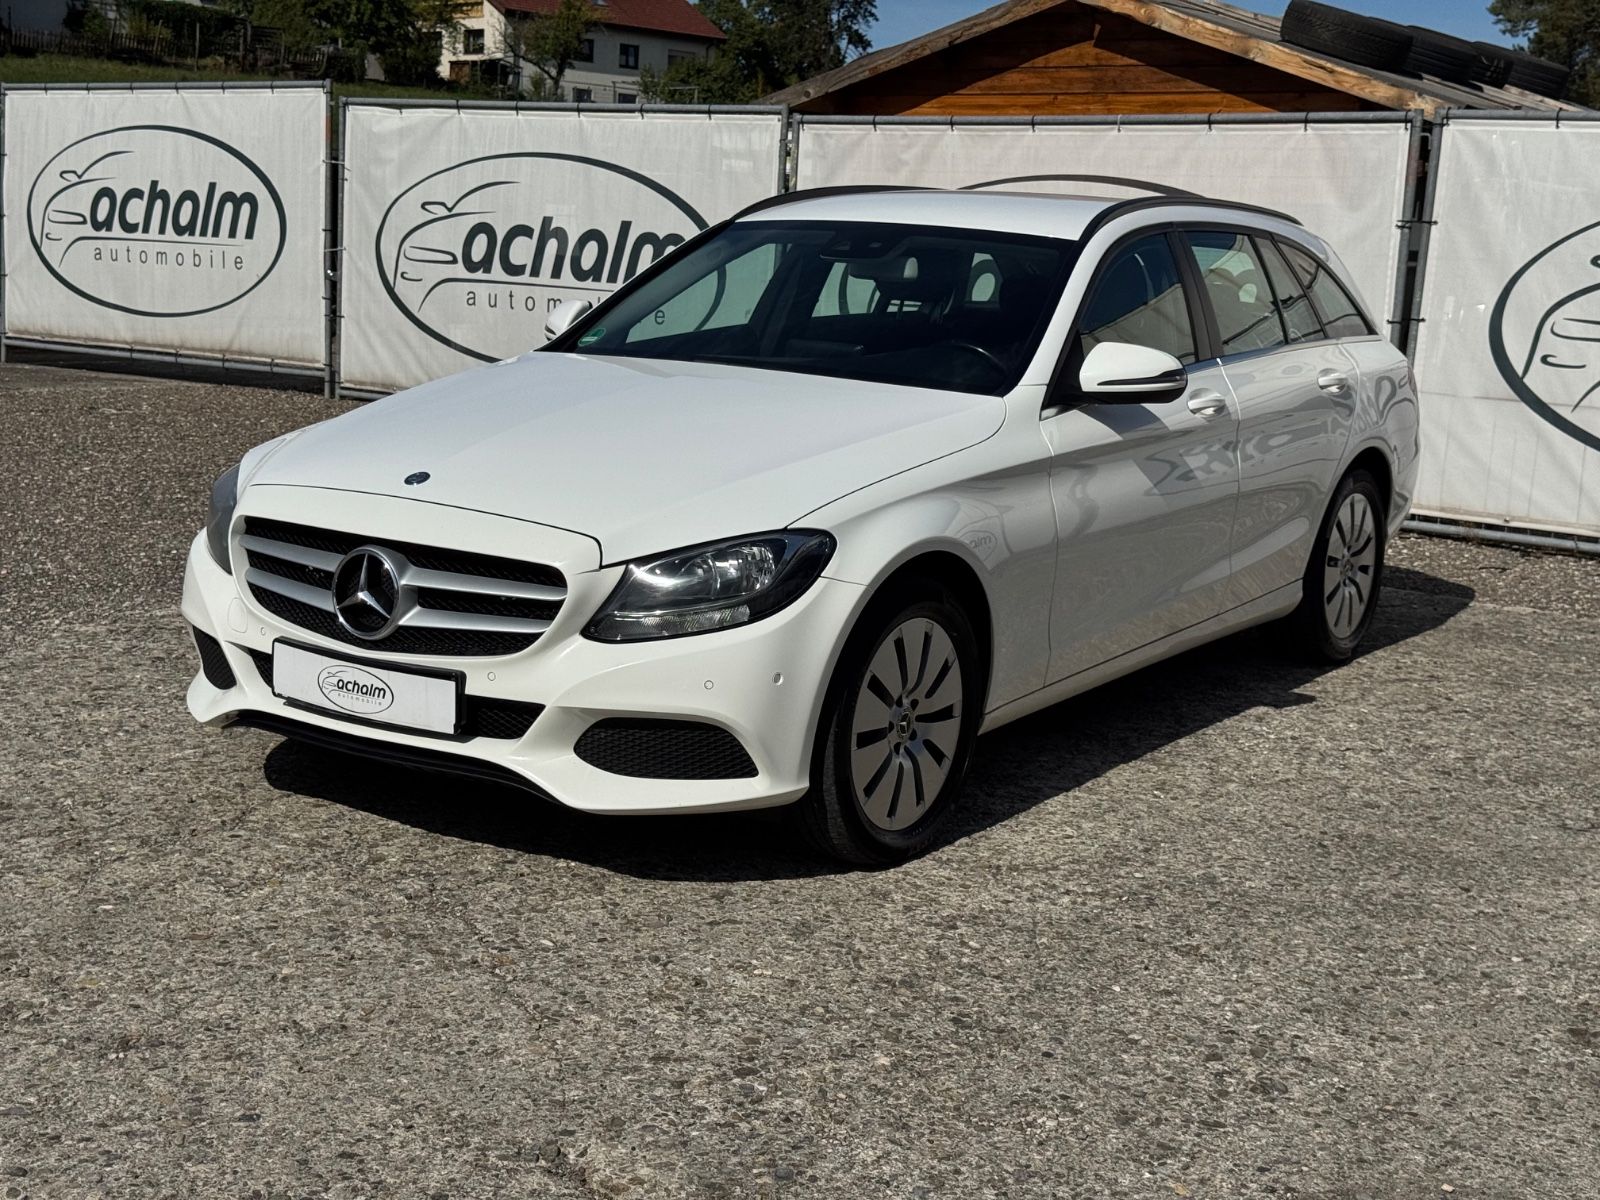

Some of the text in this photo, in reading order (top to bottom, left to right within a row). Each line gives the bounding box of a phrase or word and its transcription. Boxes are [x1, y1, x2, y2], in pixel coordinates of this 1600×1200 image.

[90, 180, 259, 240] achalm
[94, 246, 244, 270] automobile
[337, 679, 386, 699] achalm
